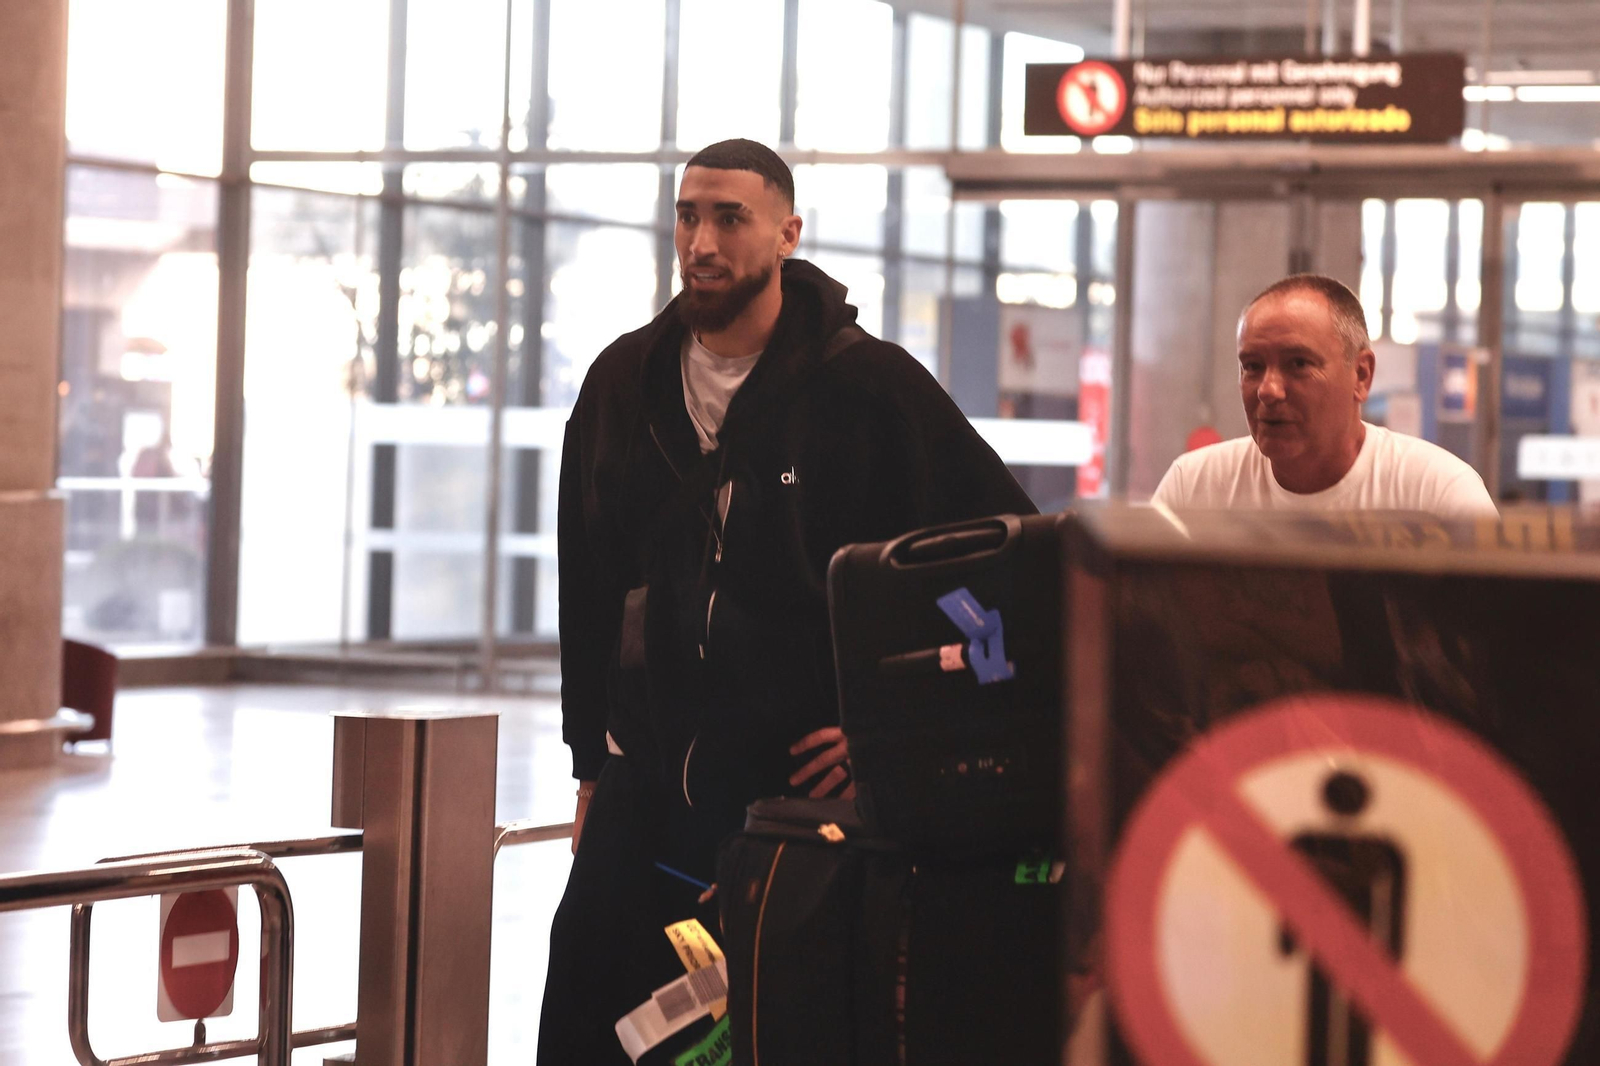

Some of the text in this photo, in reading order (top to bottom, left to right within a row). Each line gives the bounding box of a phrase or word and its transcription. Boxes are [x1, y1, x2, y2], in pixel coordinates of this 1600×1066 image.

[1133, 59, 1402, 87] Nur Personal mit Genehmigung
[1133, 85, 1358, 109] Authorized personnel only
[1186, 106, 1286, 137] personal
[1289, 105, 1411, 133] autorizado
